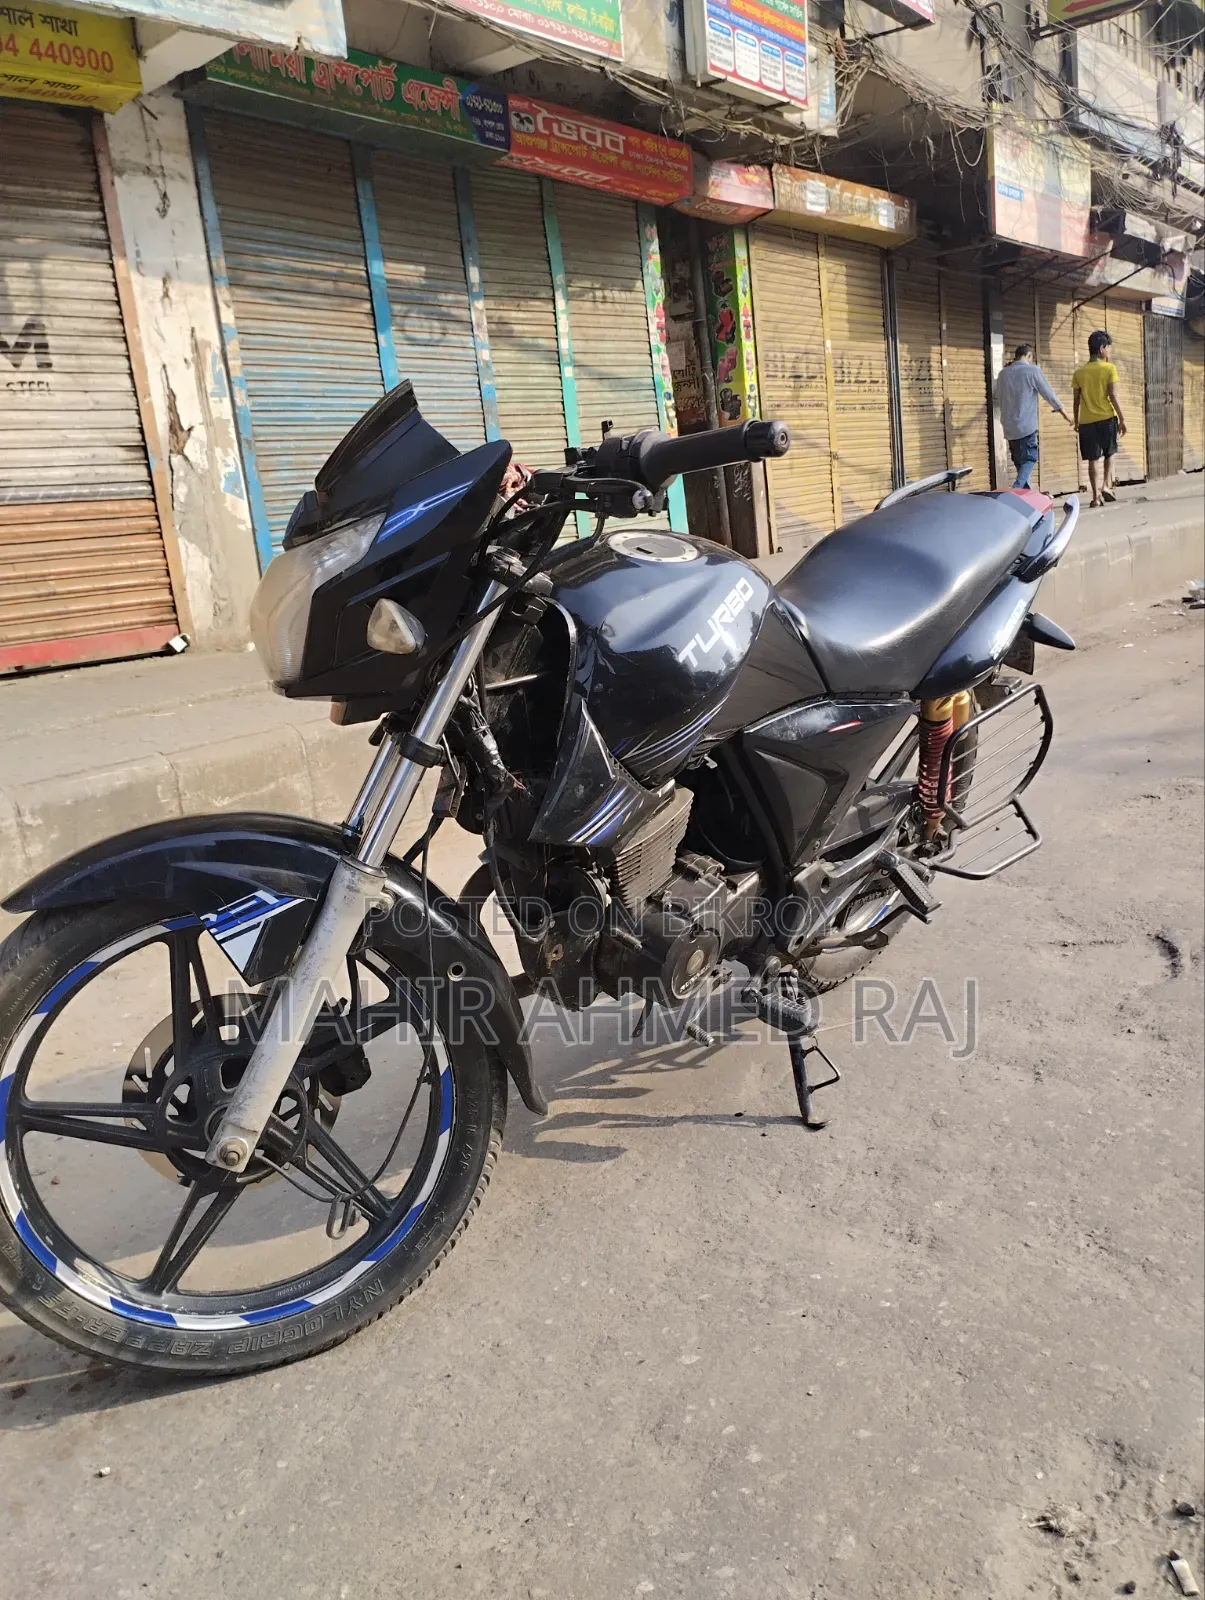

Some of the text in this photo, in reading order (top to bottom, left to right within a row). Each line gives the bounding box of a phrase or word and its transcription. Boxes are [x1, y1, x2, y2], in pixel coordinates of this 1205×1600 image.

[38, 14, 79, 36] শাখা
[0, 33, 114, 73] 4 440900
[532, 103, 626, 155] ভৈরব
[6, 380, 55, 396] STEEL
[678, 576, 754, 668] TURBO
[38, 1278, 385, 1356] NYLOGRIP ZAPPER-FS
